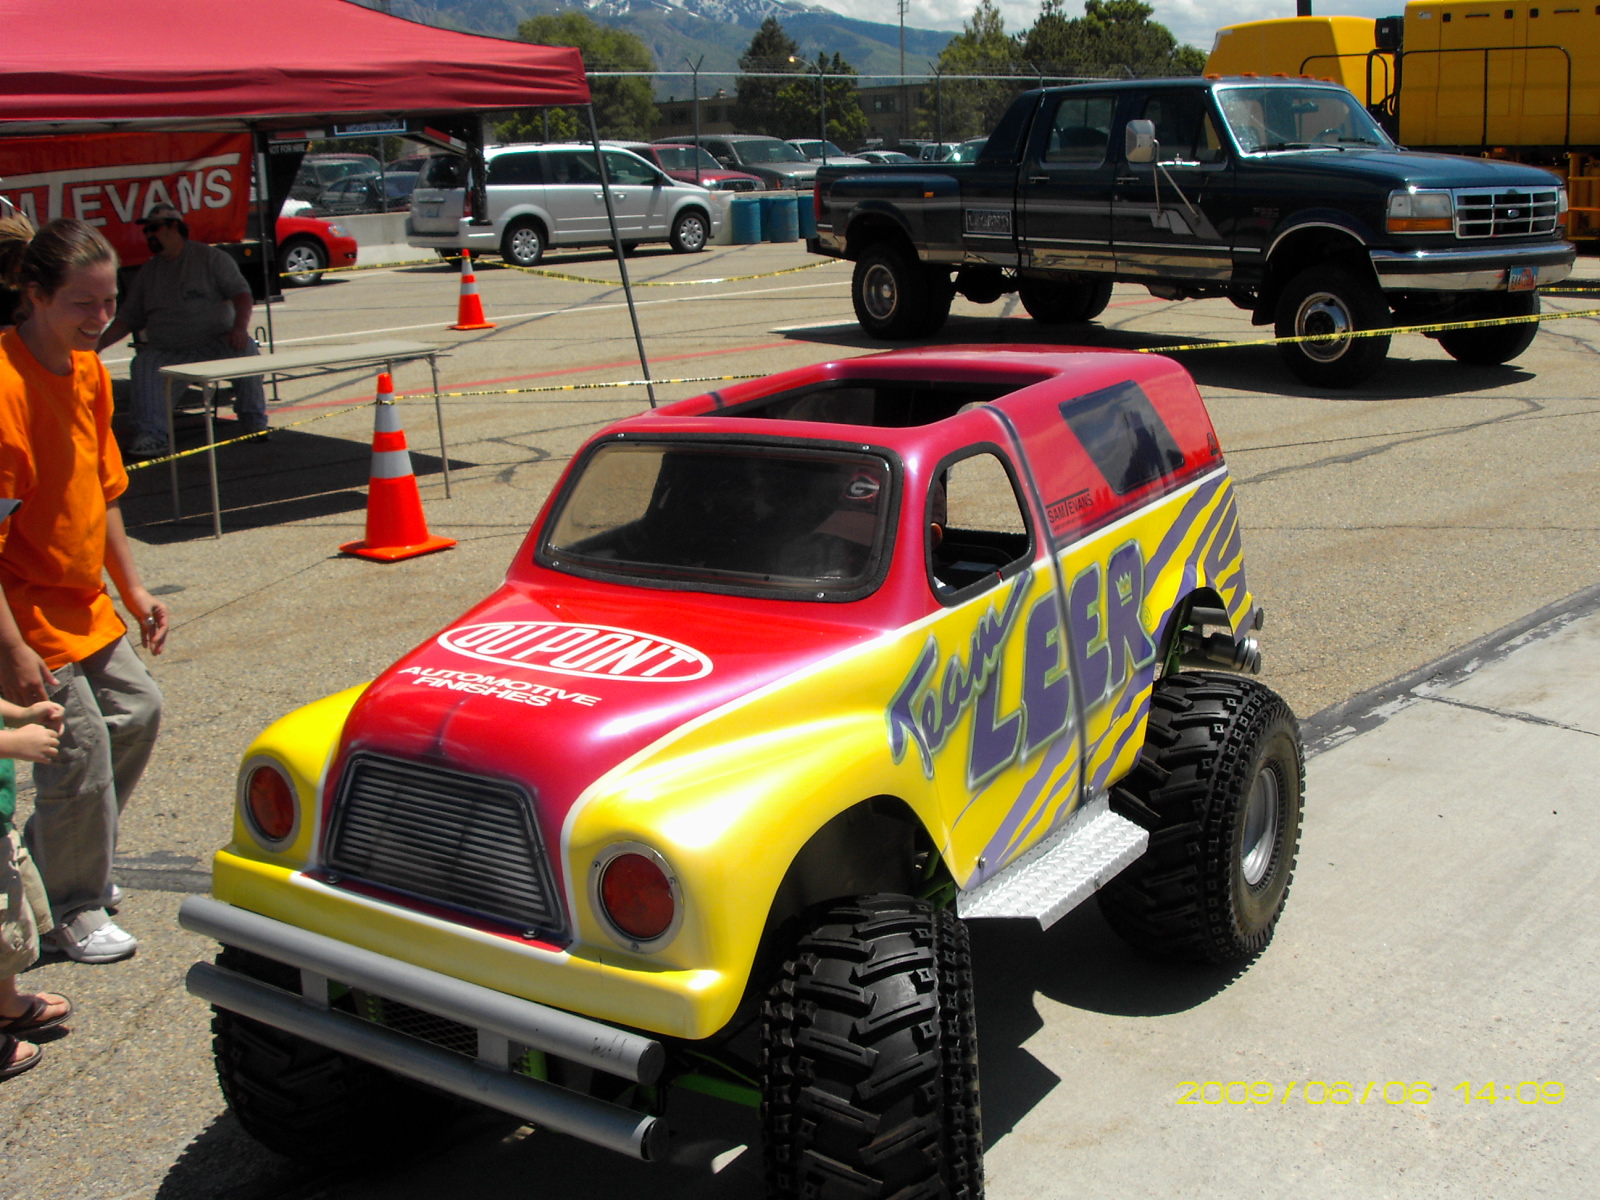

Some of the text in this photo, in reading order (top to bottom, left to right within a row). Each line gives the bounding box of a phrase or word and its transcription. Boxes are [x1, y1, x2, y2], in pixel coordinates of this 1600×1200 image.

[398, 666, 602, 707] AUTOMOTIVE
[412, 676, 551, 707] FINISHES
[885, 567, 1033, 780] Team
[967, 539, 1156, 791] LEER
